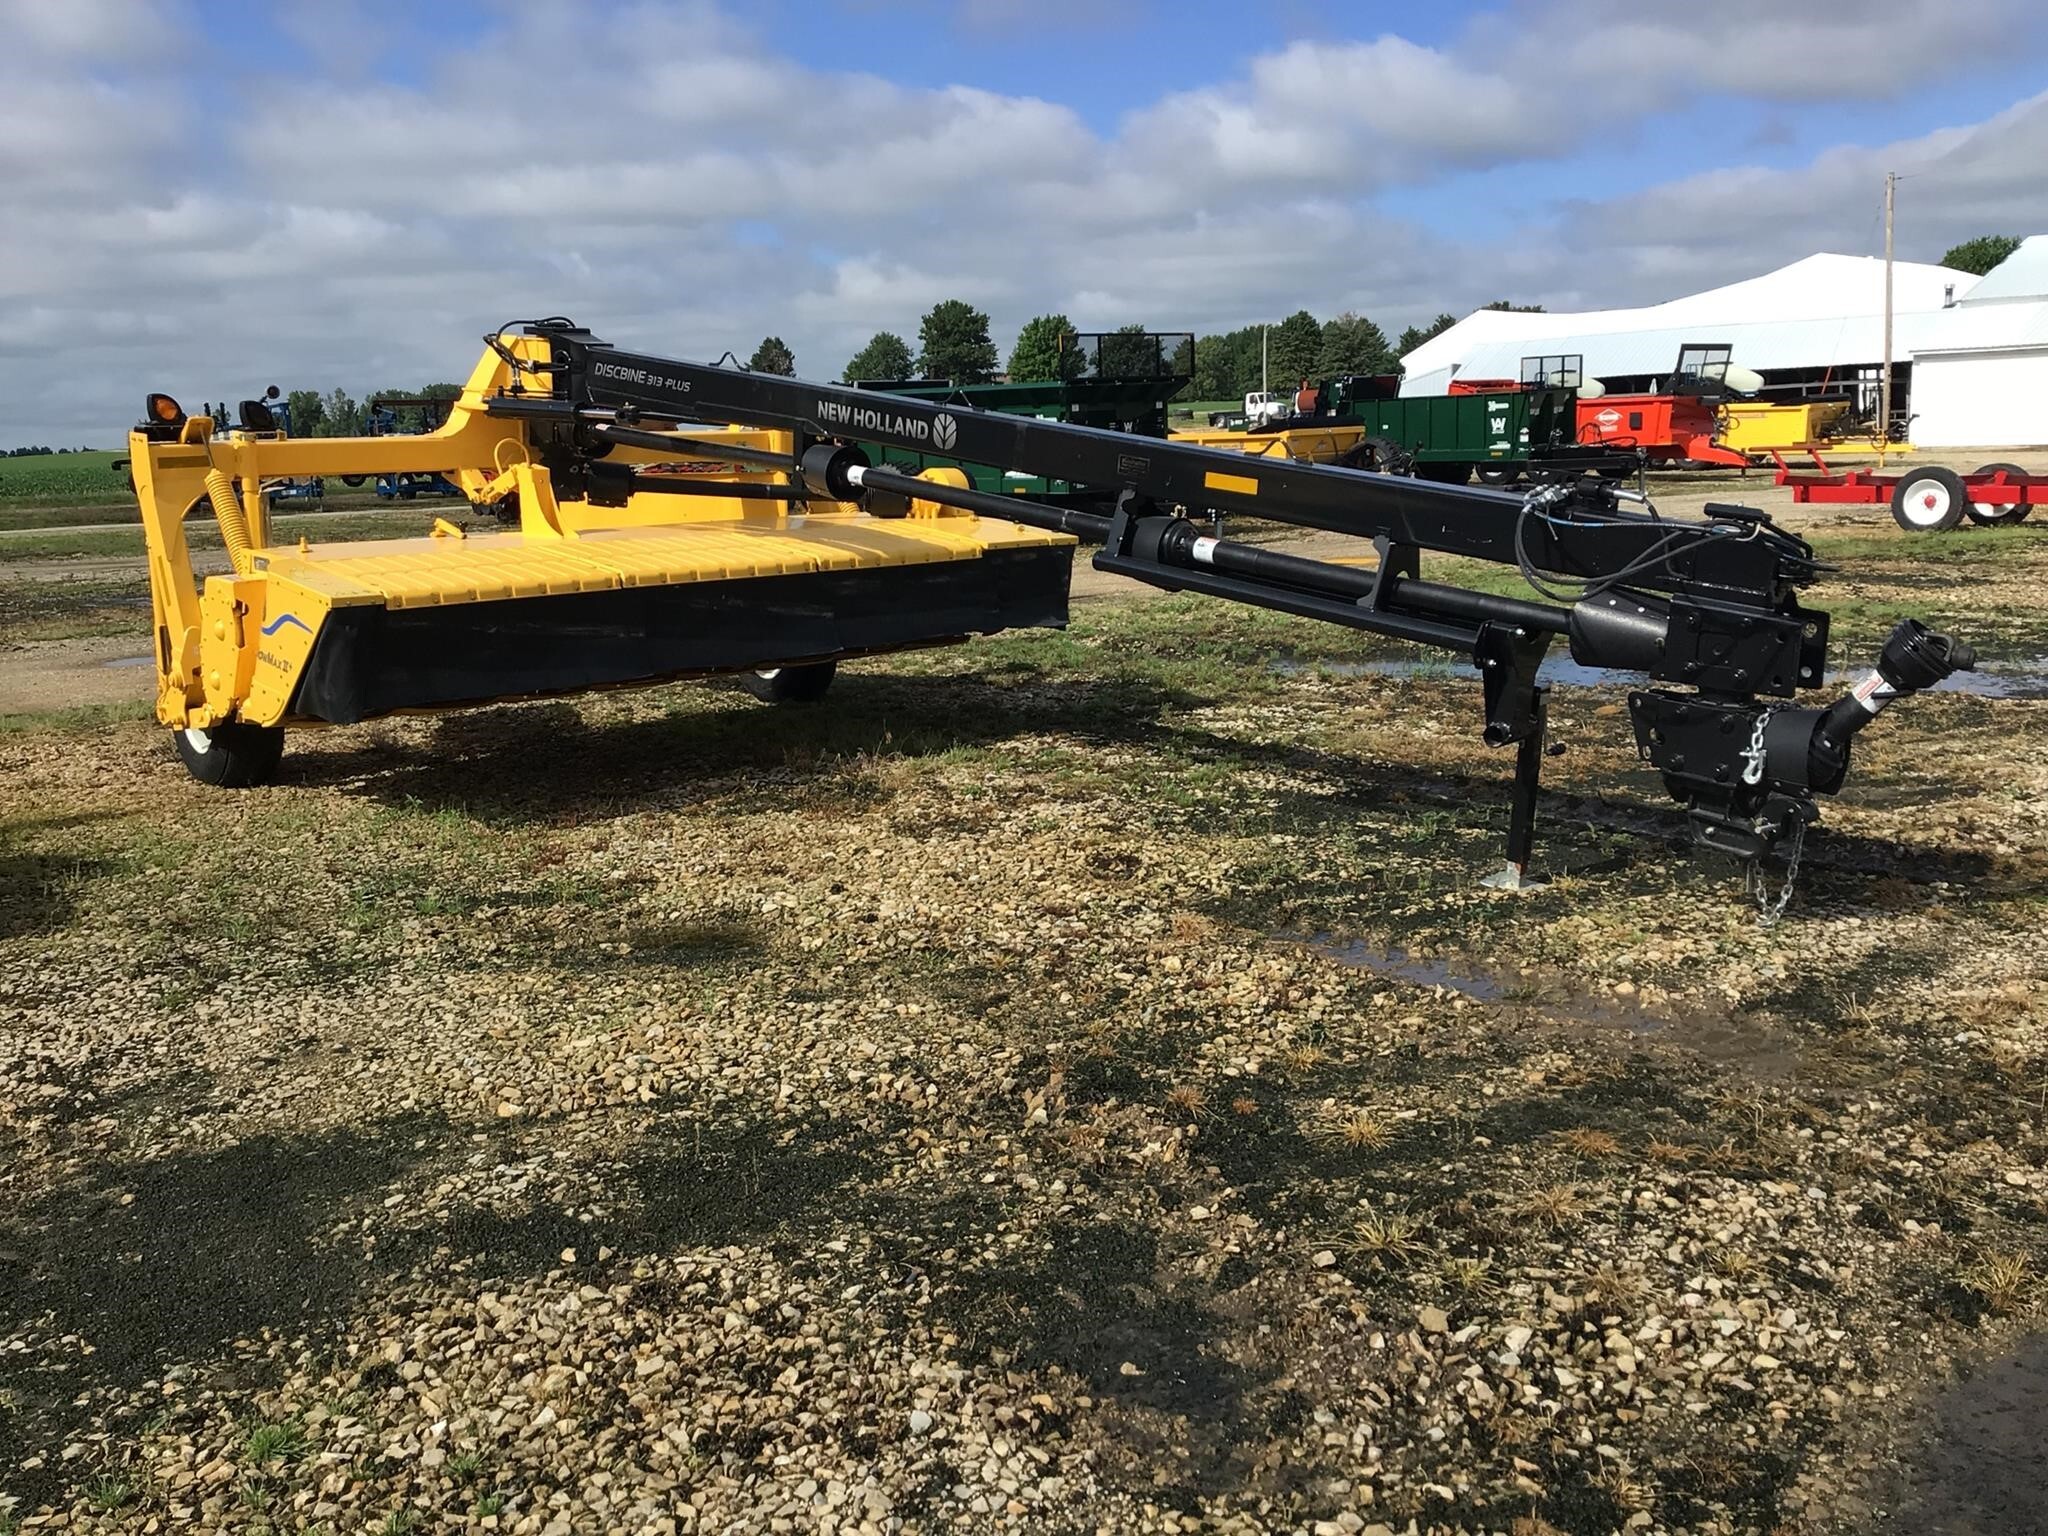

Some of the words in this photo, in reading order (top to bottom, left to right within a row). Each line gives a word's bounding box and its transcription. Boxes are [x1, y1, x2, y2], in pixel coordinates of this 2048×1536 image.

[594, 362, 647, 384] DISCBINE
[646, 375, 663, 387] 313
[664, 378, 691, 393] PLUS
[817, 400, 851, 425] NEW
[853, 412, 929, 440] HOLLAND
